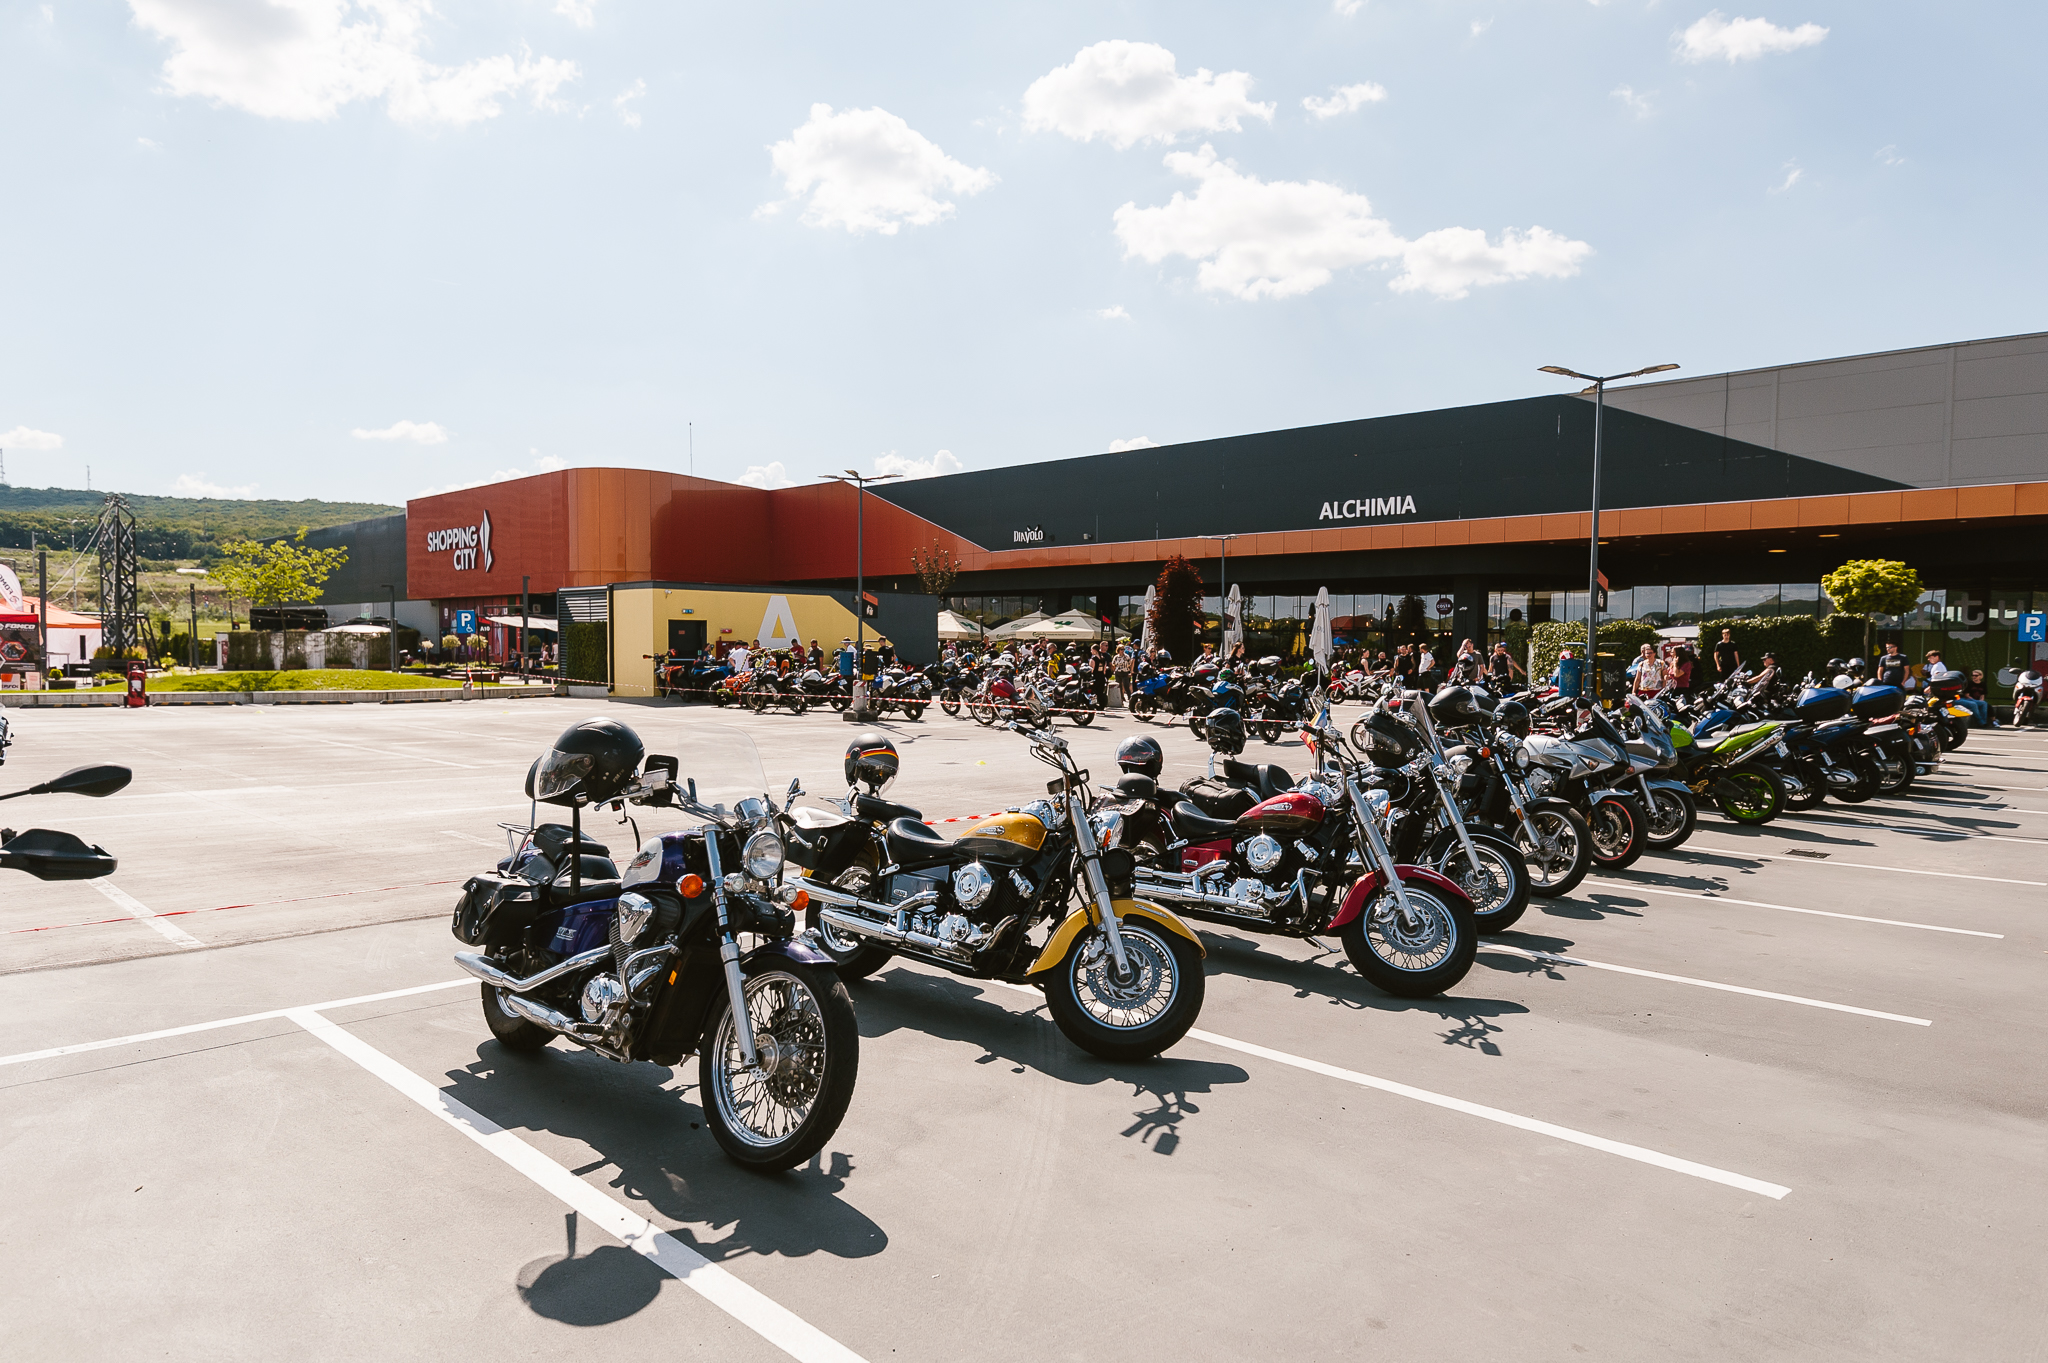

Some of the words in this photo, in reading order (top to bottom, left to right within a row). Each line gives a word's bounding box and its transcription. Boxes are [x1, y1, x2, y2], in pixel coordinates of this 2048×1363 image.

[1319, 495, 1417, 520] ALCHIMIA
[427, 525, 478, 553] SHOPPING
[1013, 529, 1044, 543] DIAVOLO
[453, 547, 477, 571] CITY
[461, 613, 471, 627] P
[757, 595, 803, 649] A
[2025, 616, 2040, 634] P
